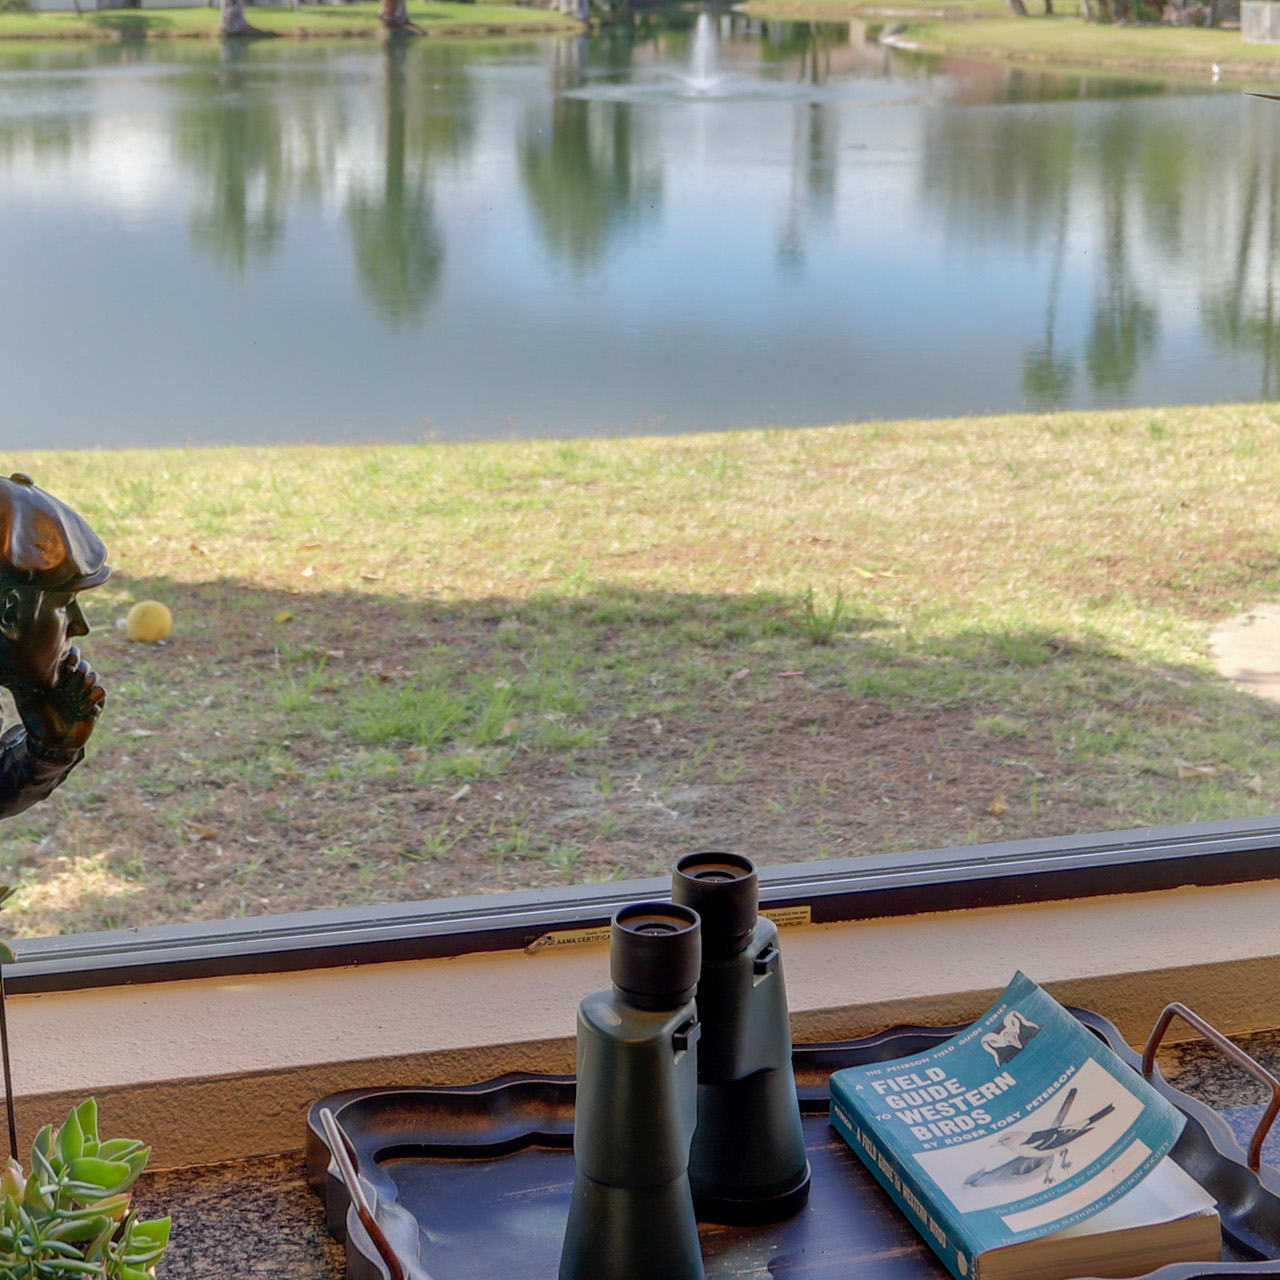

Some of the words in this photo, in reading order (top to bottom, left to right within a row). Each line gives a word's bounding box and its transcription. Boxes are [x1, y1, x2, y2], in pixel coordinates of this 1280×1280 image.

[864, 1069, 882, 1077] THE
[886, 1057, 930, 1073] PETERSON
[933, 1046, 955, 1059] FIELD
[958, 1028, 983, 1046] GUIDE
[985, 1004, 1007, 1025] SERIES
[871, 1066, 947, 1095] FIELD
[876, 1113, 892, 1122] TO
[894, 1071, 1017, 1125] WESTERN
[884, 1078, 966, 1110] GUIDE
[922, 1141, 939, 1150] BY
[944, 1128, 987, 1144] ROGER
[990, 1111, 1021, 1130] TORY
[1025, 1065, 1076, 1112] PETERSON
[910, 1109, 992, 1141] BIRDS
[1061, 1201, 1105, 1226] NATIONAL
[1106, 1171, 1144, 1201] AUDUBON
